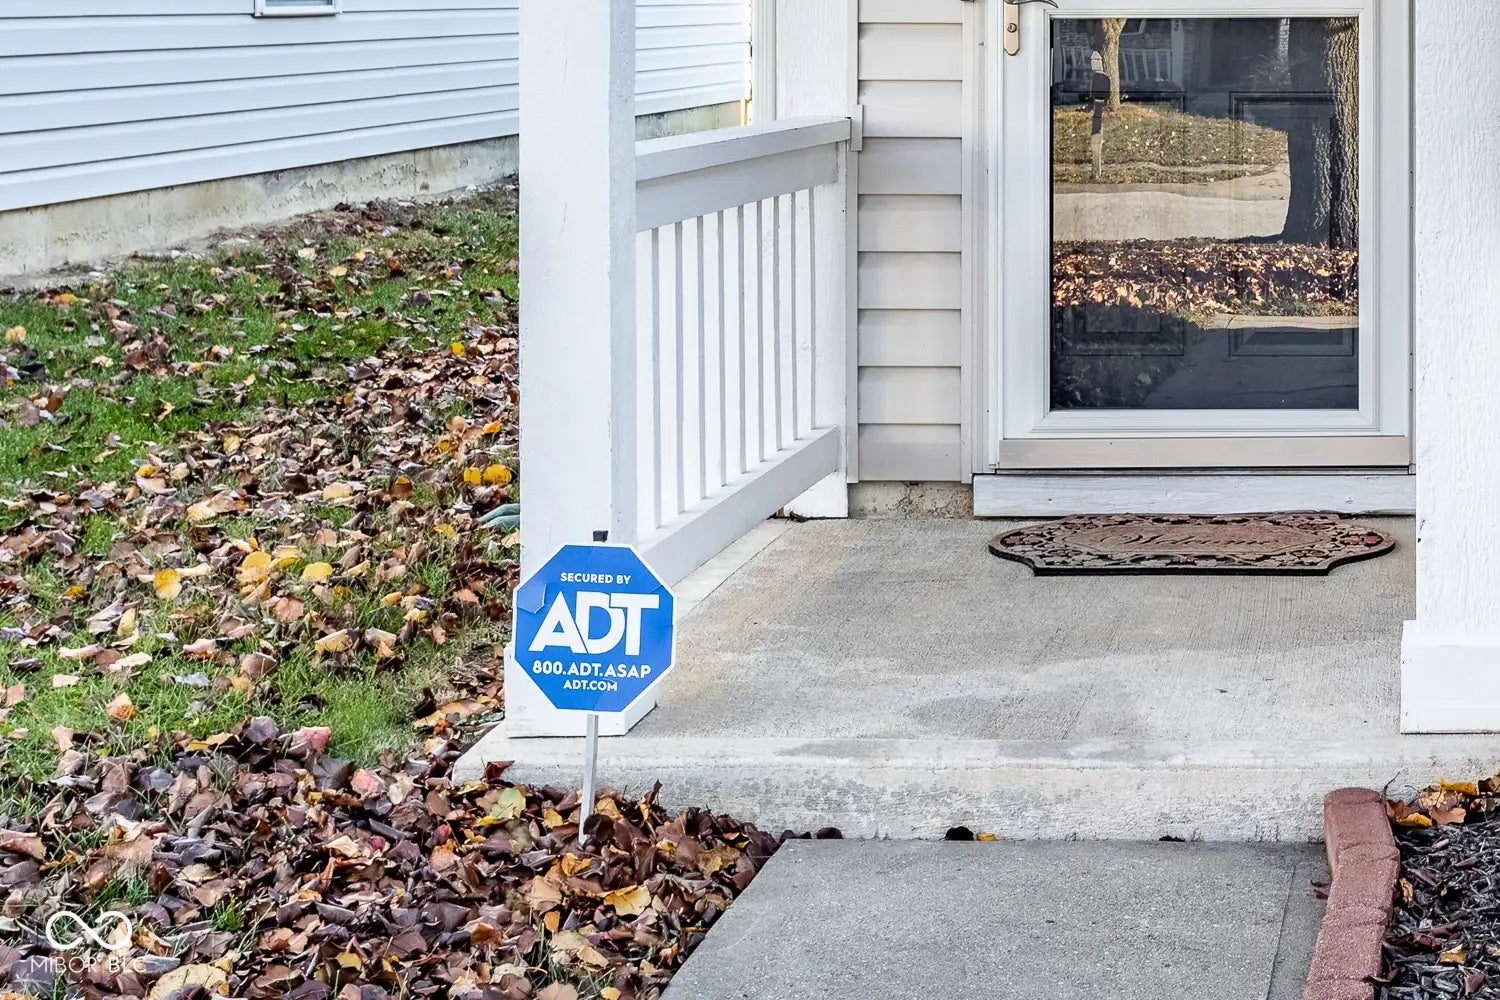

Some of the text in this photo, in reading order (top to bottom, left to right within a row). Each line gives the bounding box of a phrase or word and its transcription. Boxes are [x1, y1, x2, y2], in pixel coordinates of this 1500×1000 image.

[560, 572, 631, 584] SECURED BY
[528, 590, 659, 656] ADT
[532, 660, 651, 679] 800.ADT.ASAP
[563, 679, 618, 691] ADT.COM
